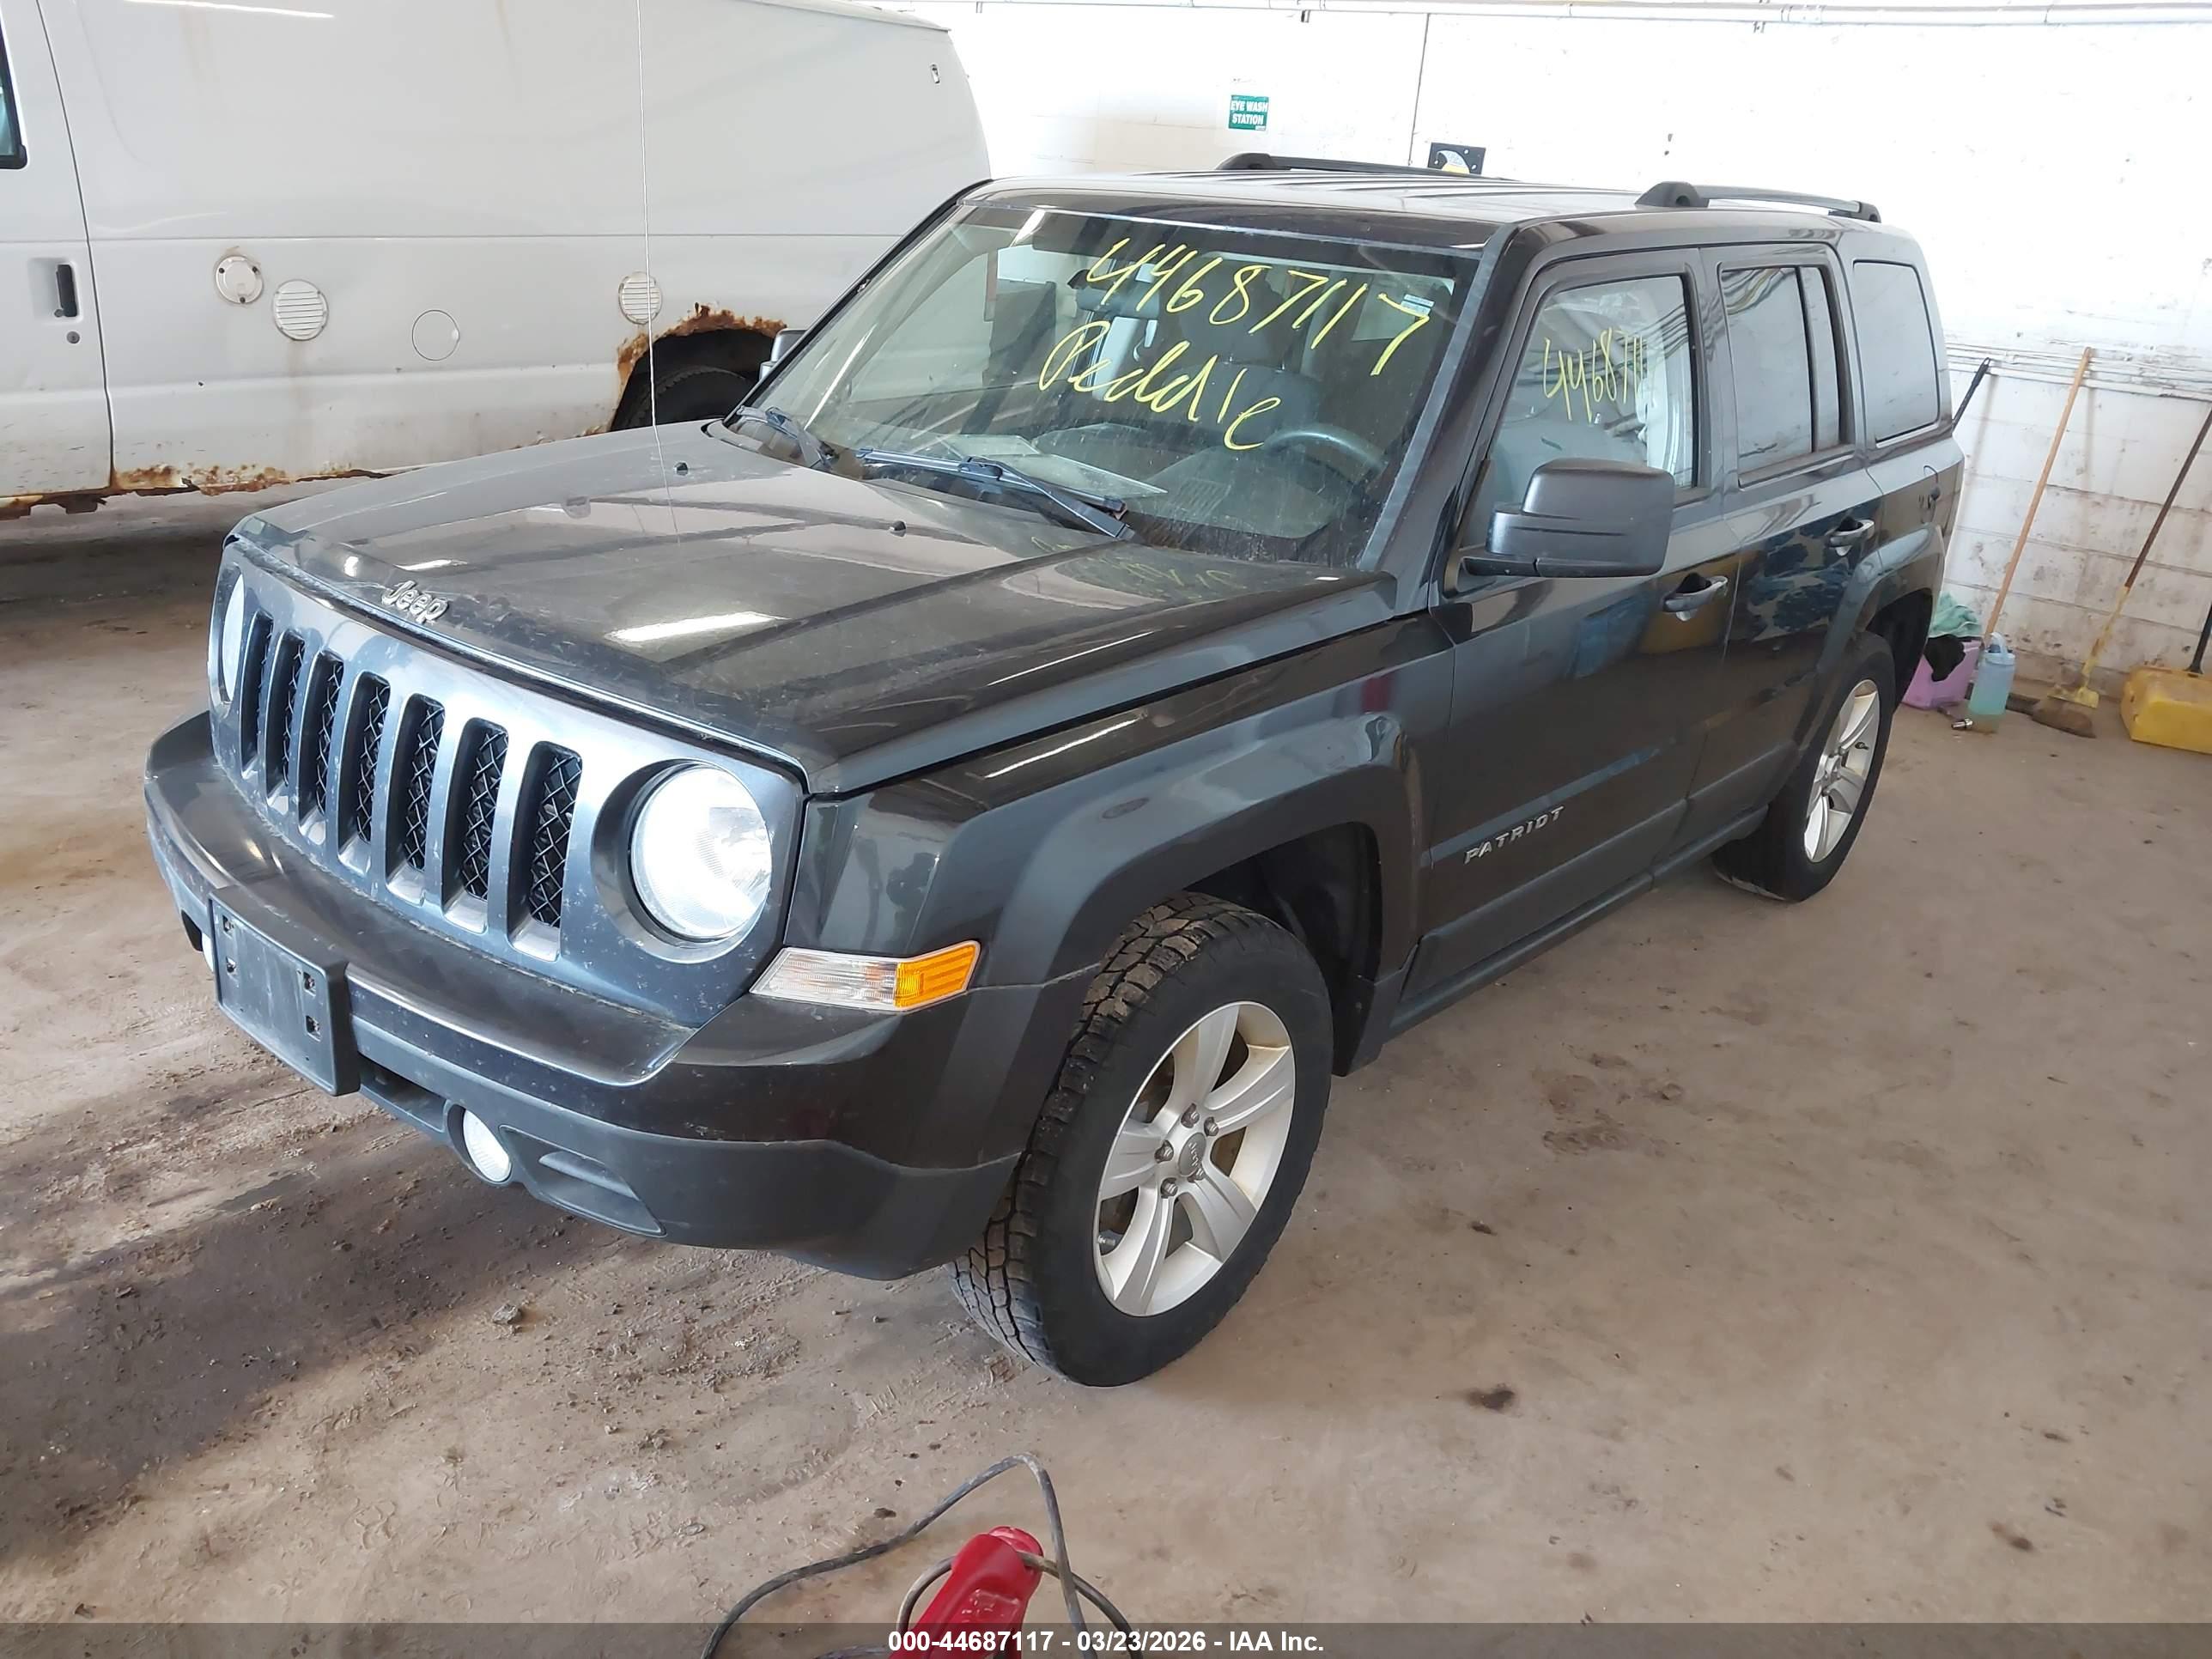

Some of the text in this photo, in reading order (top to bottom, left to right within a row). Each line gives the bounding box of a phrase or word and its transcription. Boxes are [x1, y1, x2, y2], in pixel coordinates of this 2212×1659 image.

[1231, 100, 1268, 112] EYE WASH
[1232, 113, 1264, 125] STATION
[1086, 238, 1430, 376] 44687117
[381, 580, 449, 623] Jeep
[1464, 805, 1565, 865] PATRIOT
